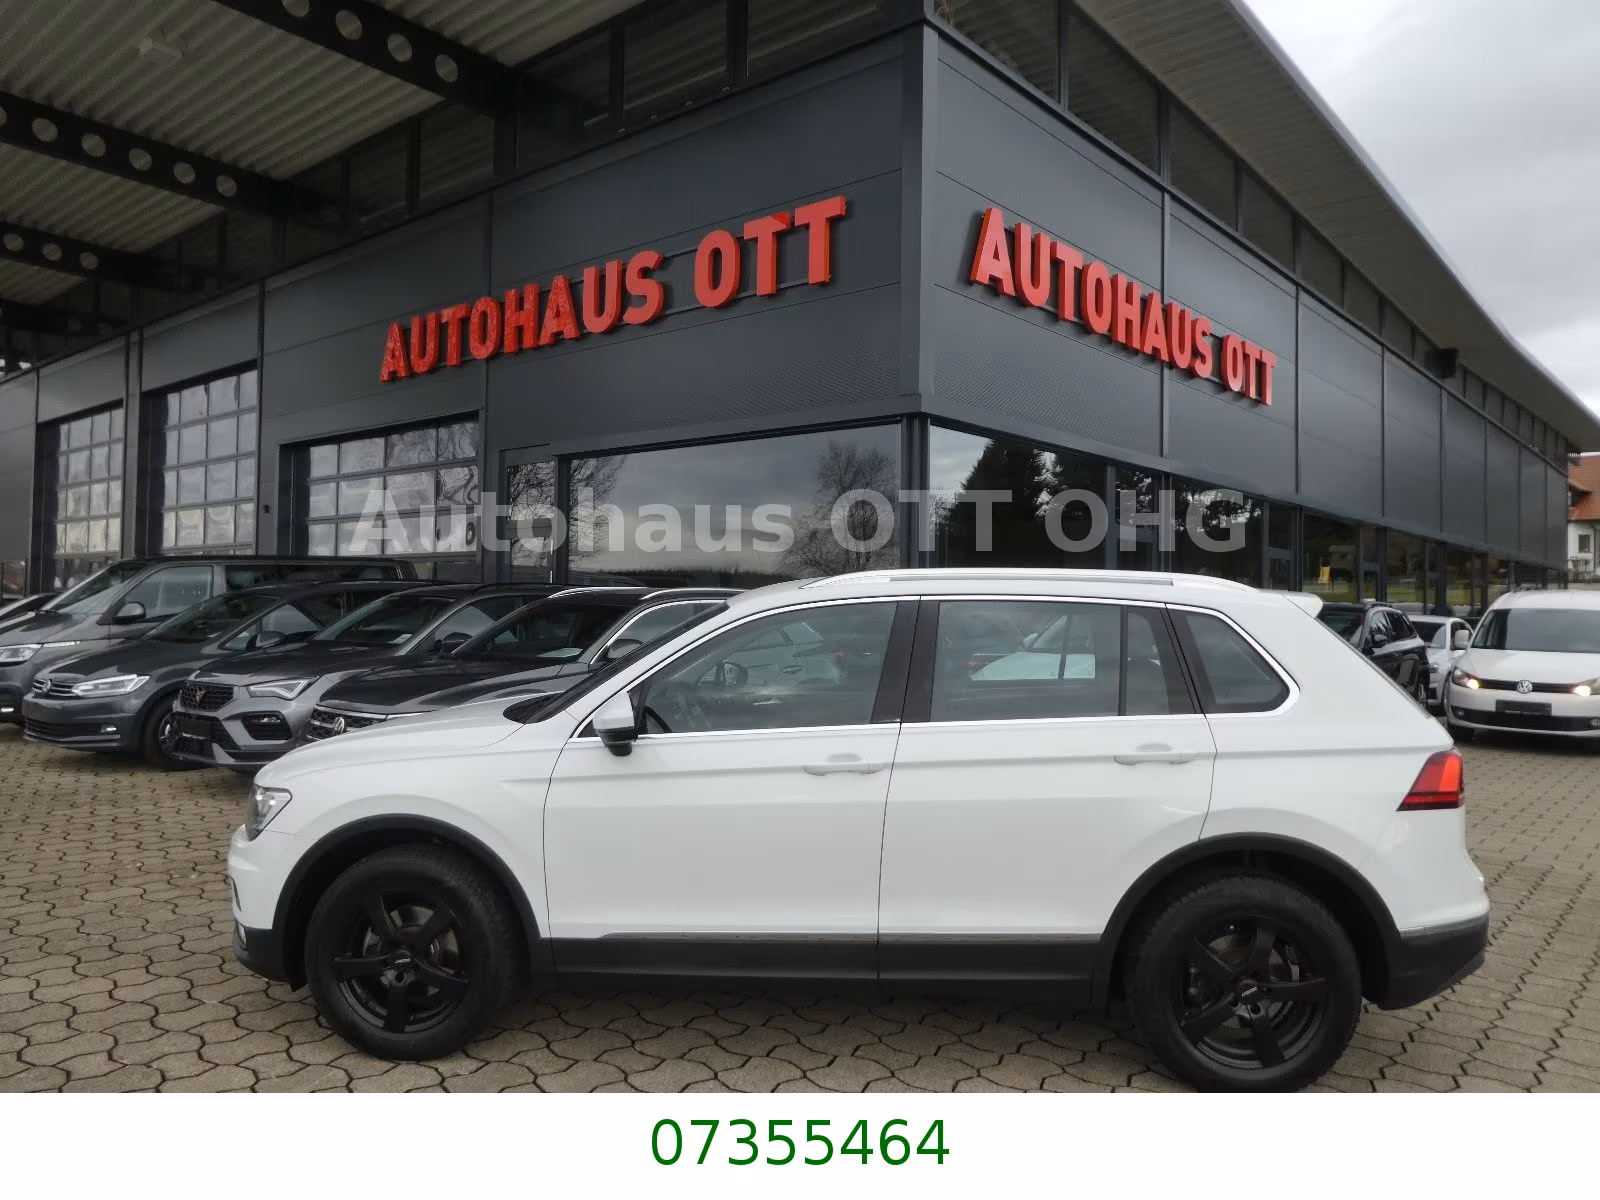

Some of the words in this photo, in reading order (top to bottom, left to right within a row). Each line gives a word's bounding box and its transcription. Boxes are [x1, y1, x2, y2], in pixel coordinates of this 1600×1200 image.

[380, 250, 665, 382] AUTOHAUS
[694, 196, 847, 308] OTT
[969, 207, 1214, 379] AUTOHAUS
[1221, 334, 1277, 406] OTT
